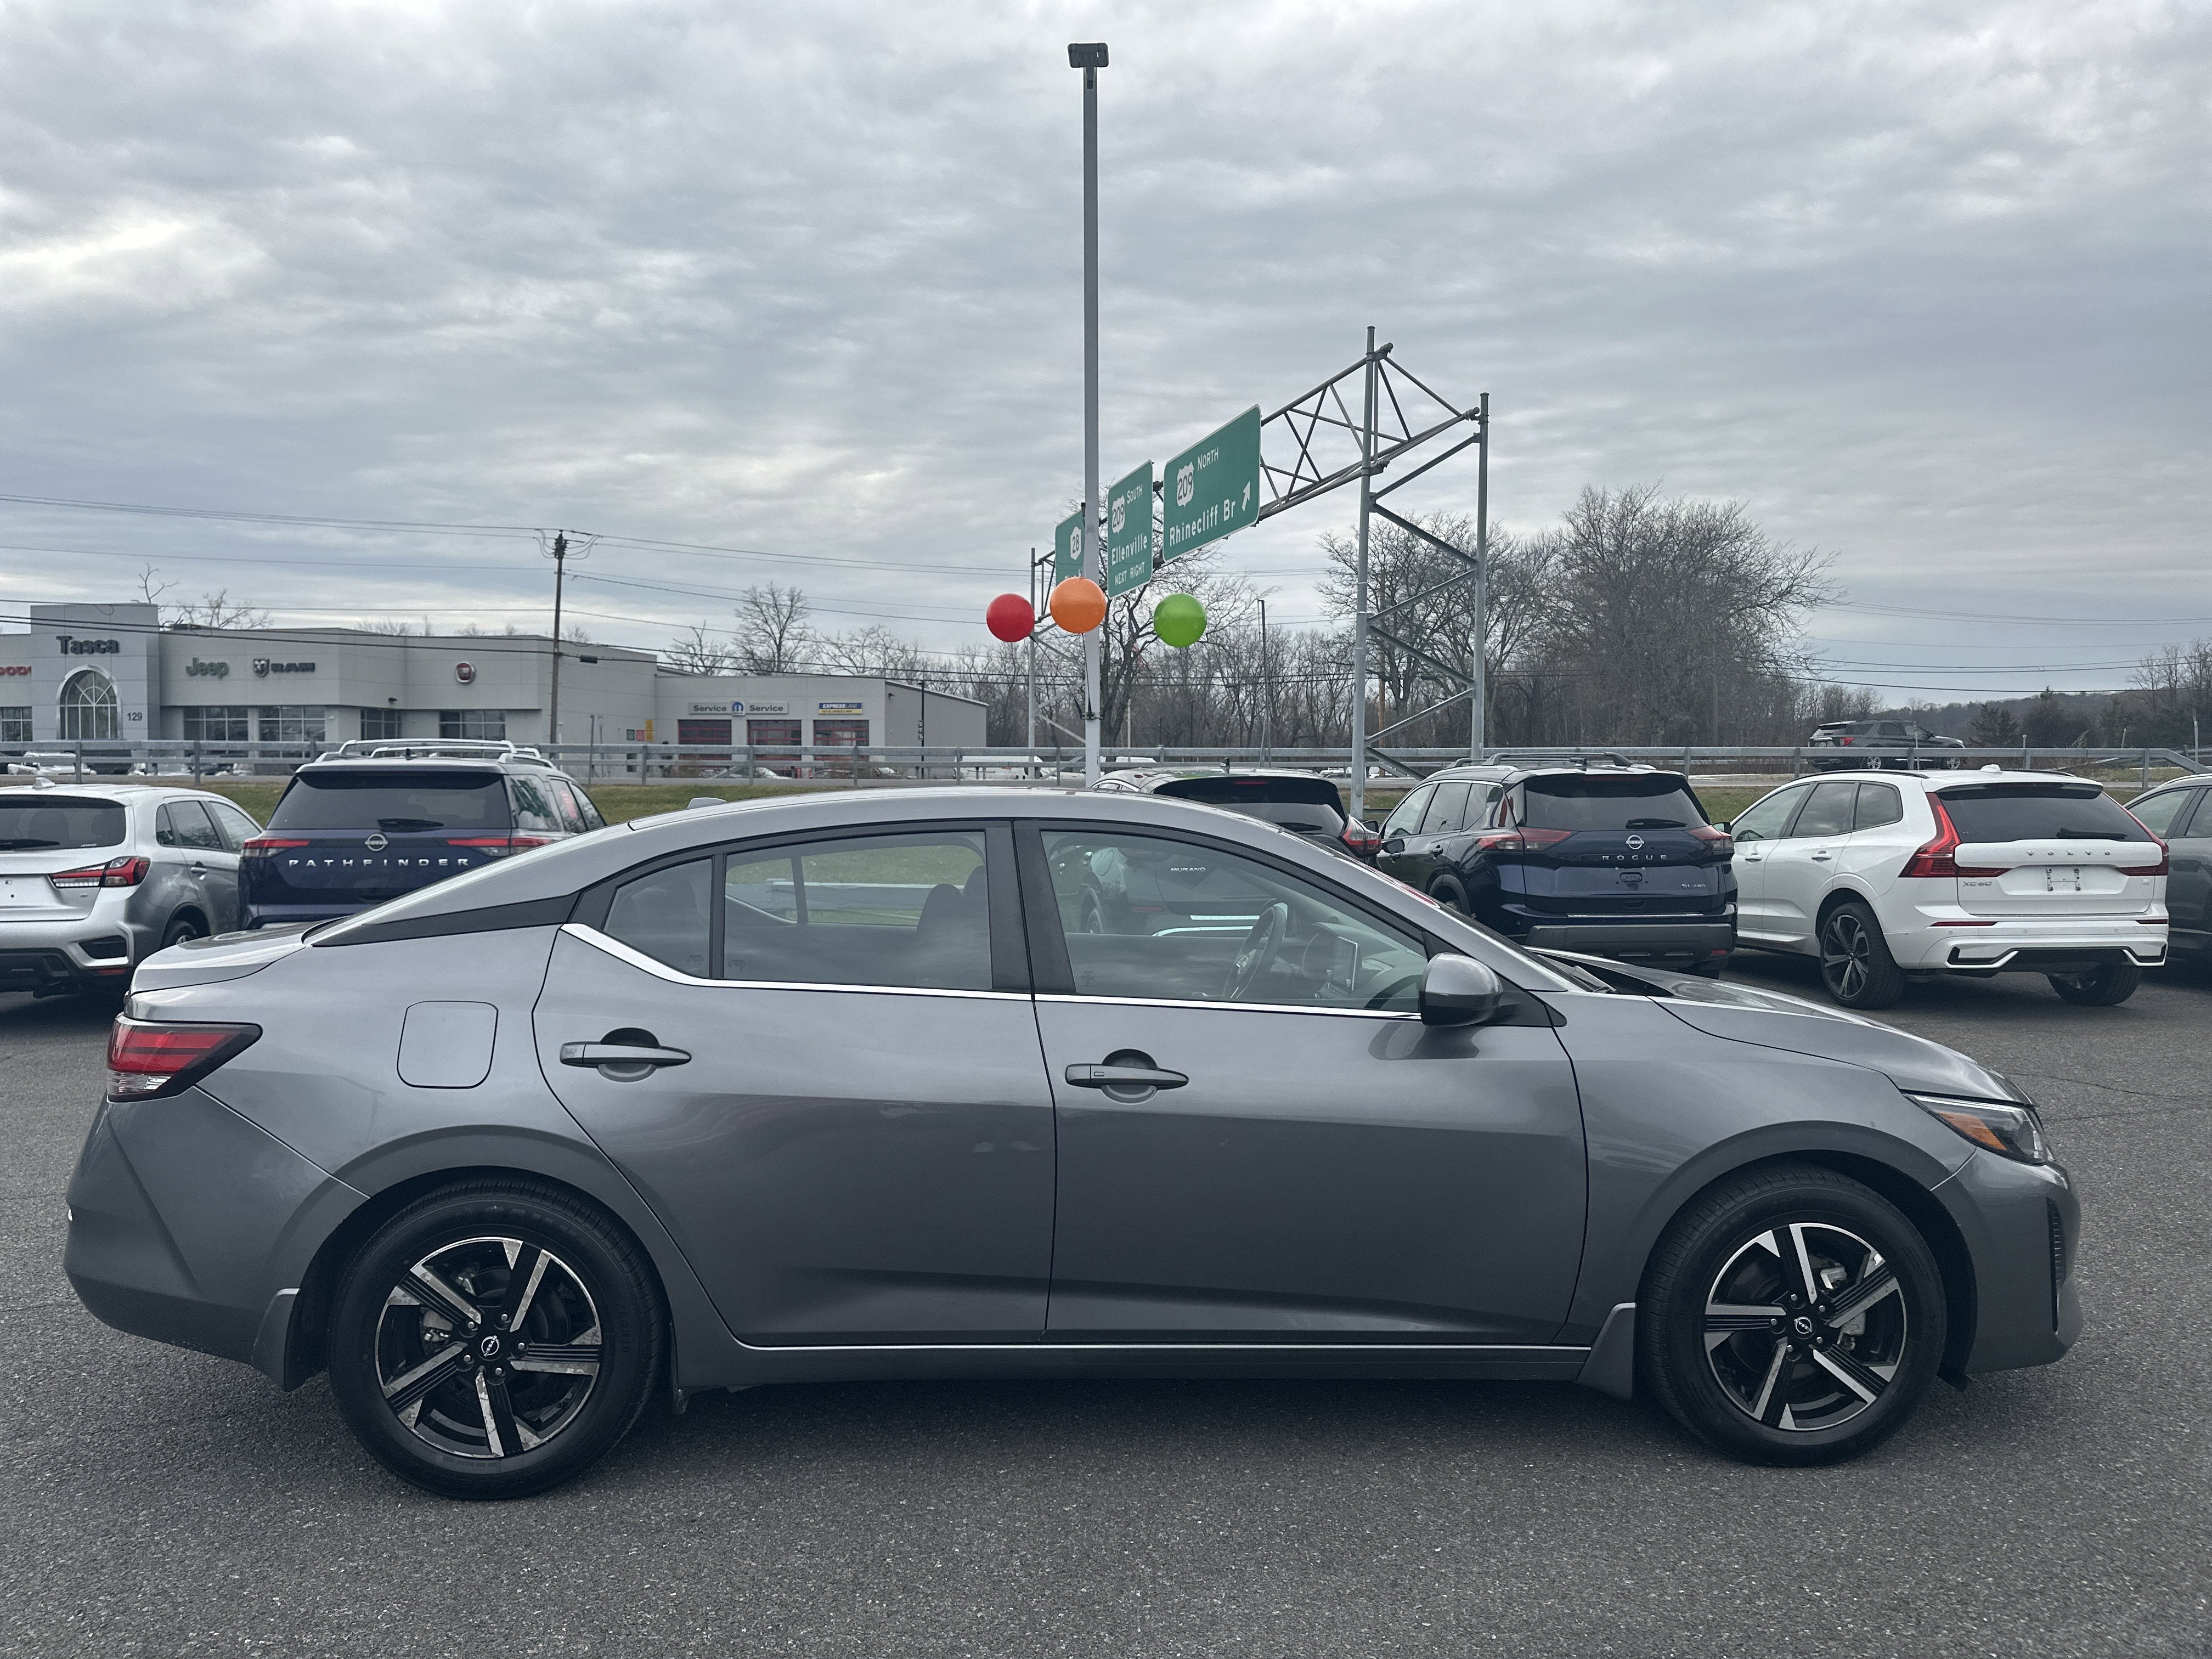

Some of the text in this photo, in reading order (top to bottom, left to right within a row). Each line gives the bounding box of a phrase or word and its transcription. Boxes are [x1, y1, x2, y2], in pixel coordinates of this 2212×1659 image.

[1197, 447, 1219, 472] NORTH
[1126, 484, 1143, 504] SOUTH
[1177, 472, 1193, 501] 209
[1113, 504, 1125, 528] 209
[1170, 499, 1235, 547] Rhinecliff Br
[1072, 534, 1080, 554] 28
[1111, 533, 1148, 566] Ellenville
[1114, 561, 1146, 586] NEXT RIGHT
[56, 636, 120, 654] Tasca
[185, 657, 229, 679] Jeep
[271, 662, 315, 673] RAM
[127, 712, 143, 721] 129
[289, 858, 469, 868] PATHFINDER
